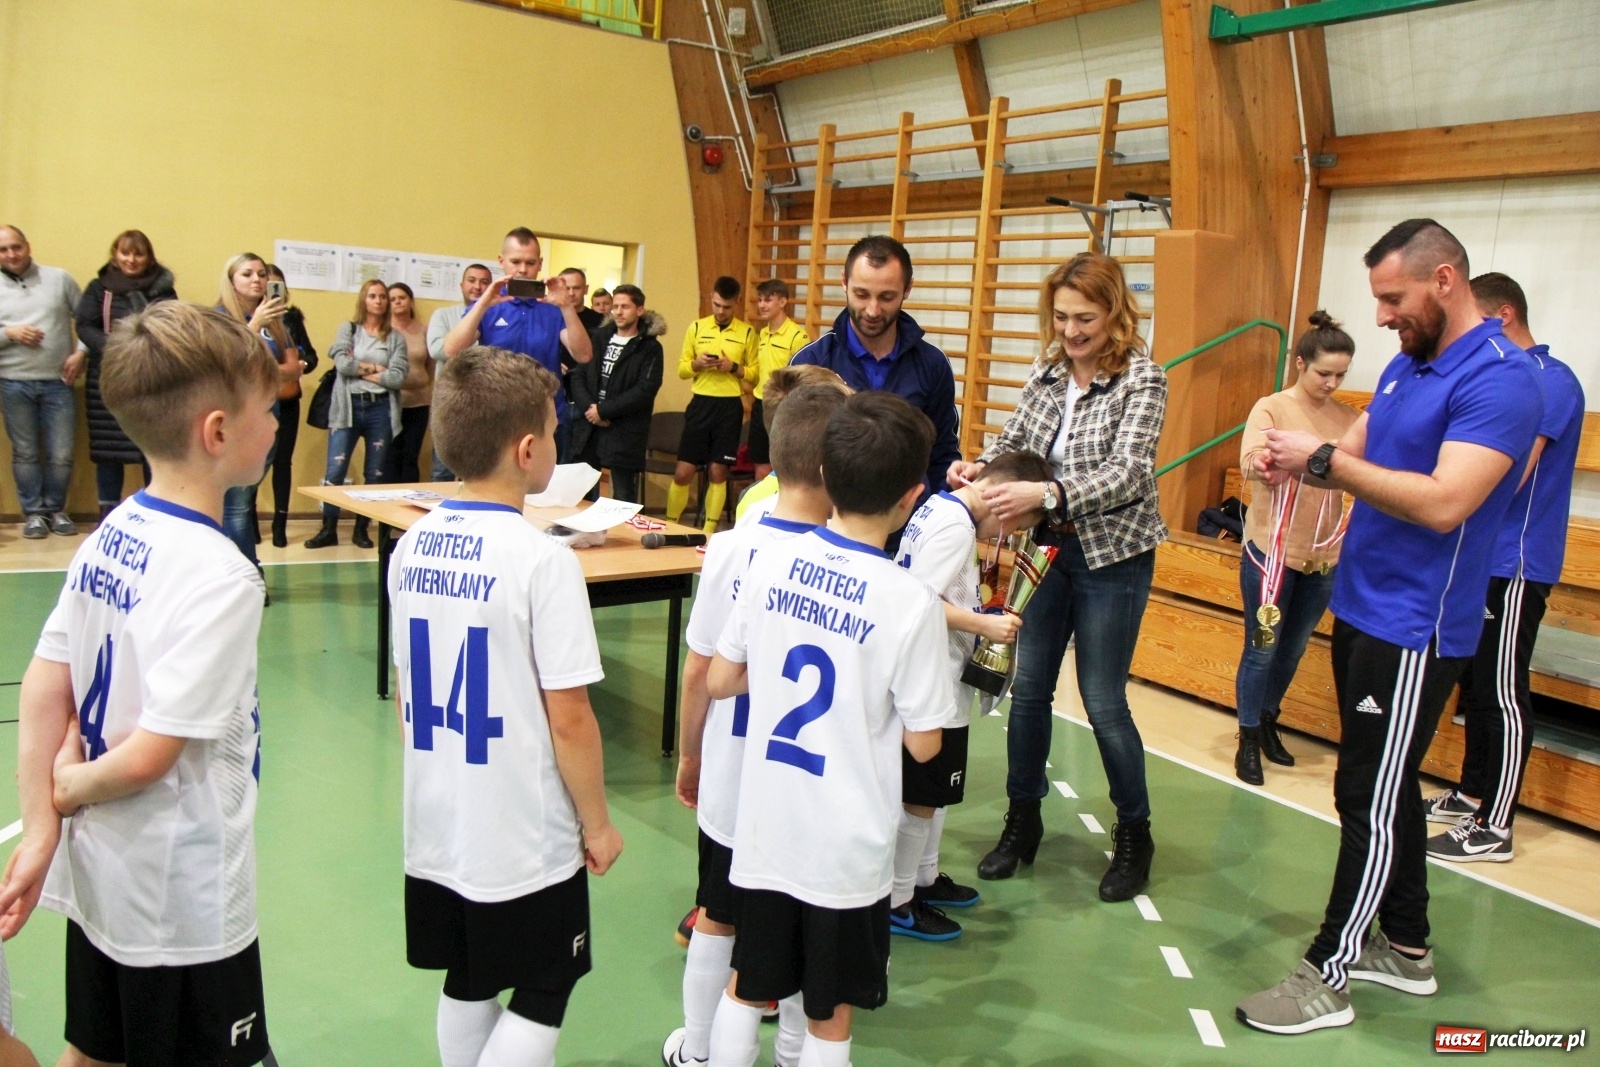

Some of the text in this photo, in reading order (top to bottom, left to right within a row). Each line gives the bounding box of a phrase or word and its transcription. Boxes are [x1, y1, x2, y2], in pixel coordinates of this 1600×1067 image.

[413, 530, 484, 562] FORTECA
[788, 557, 868, 606] FORTECA
[765, 582, 876, 645] ŚWIERKLANY
[405, 617, 504, 765] 44
[765, 643, 836, 778] 2
[1355, 705, 1383, 714] adidas
